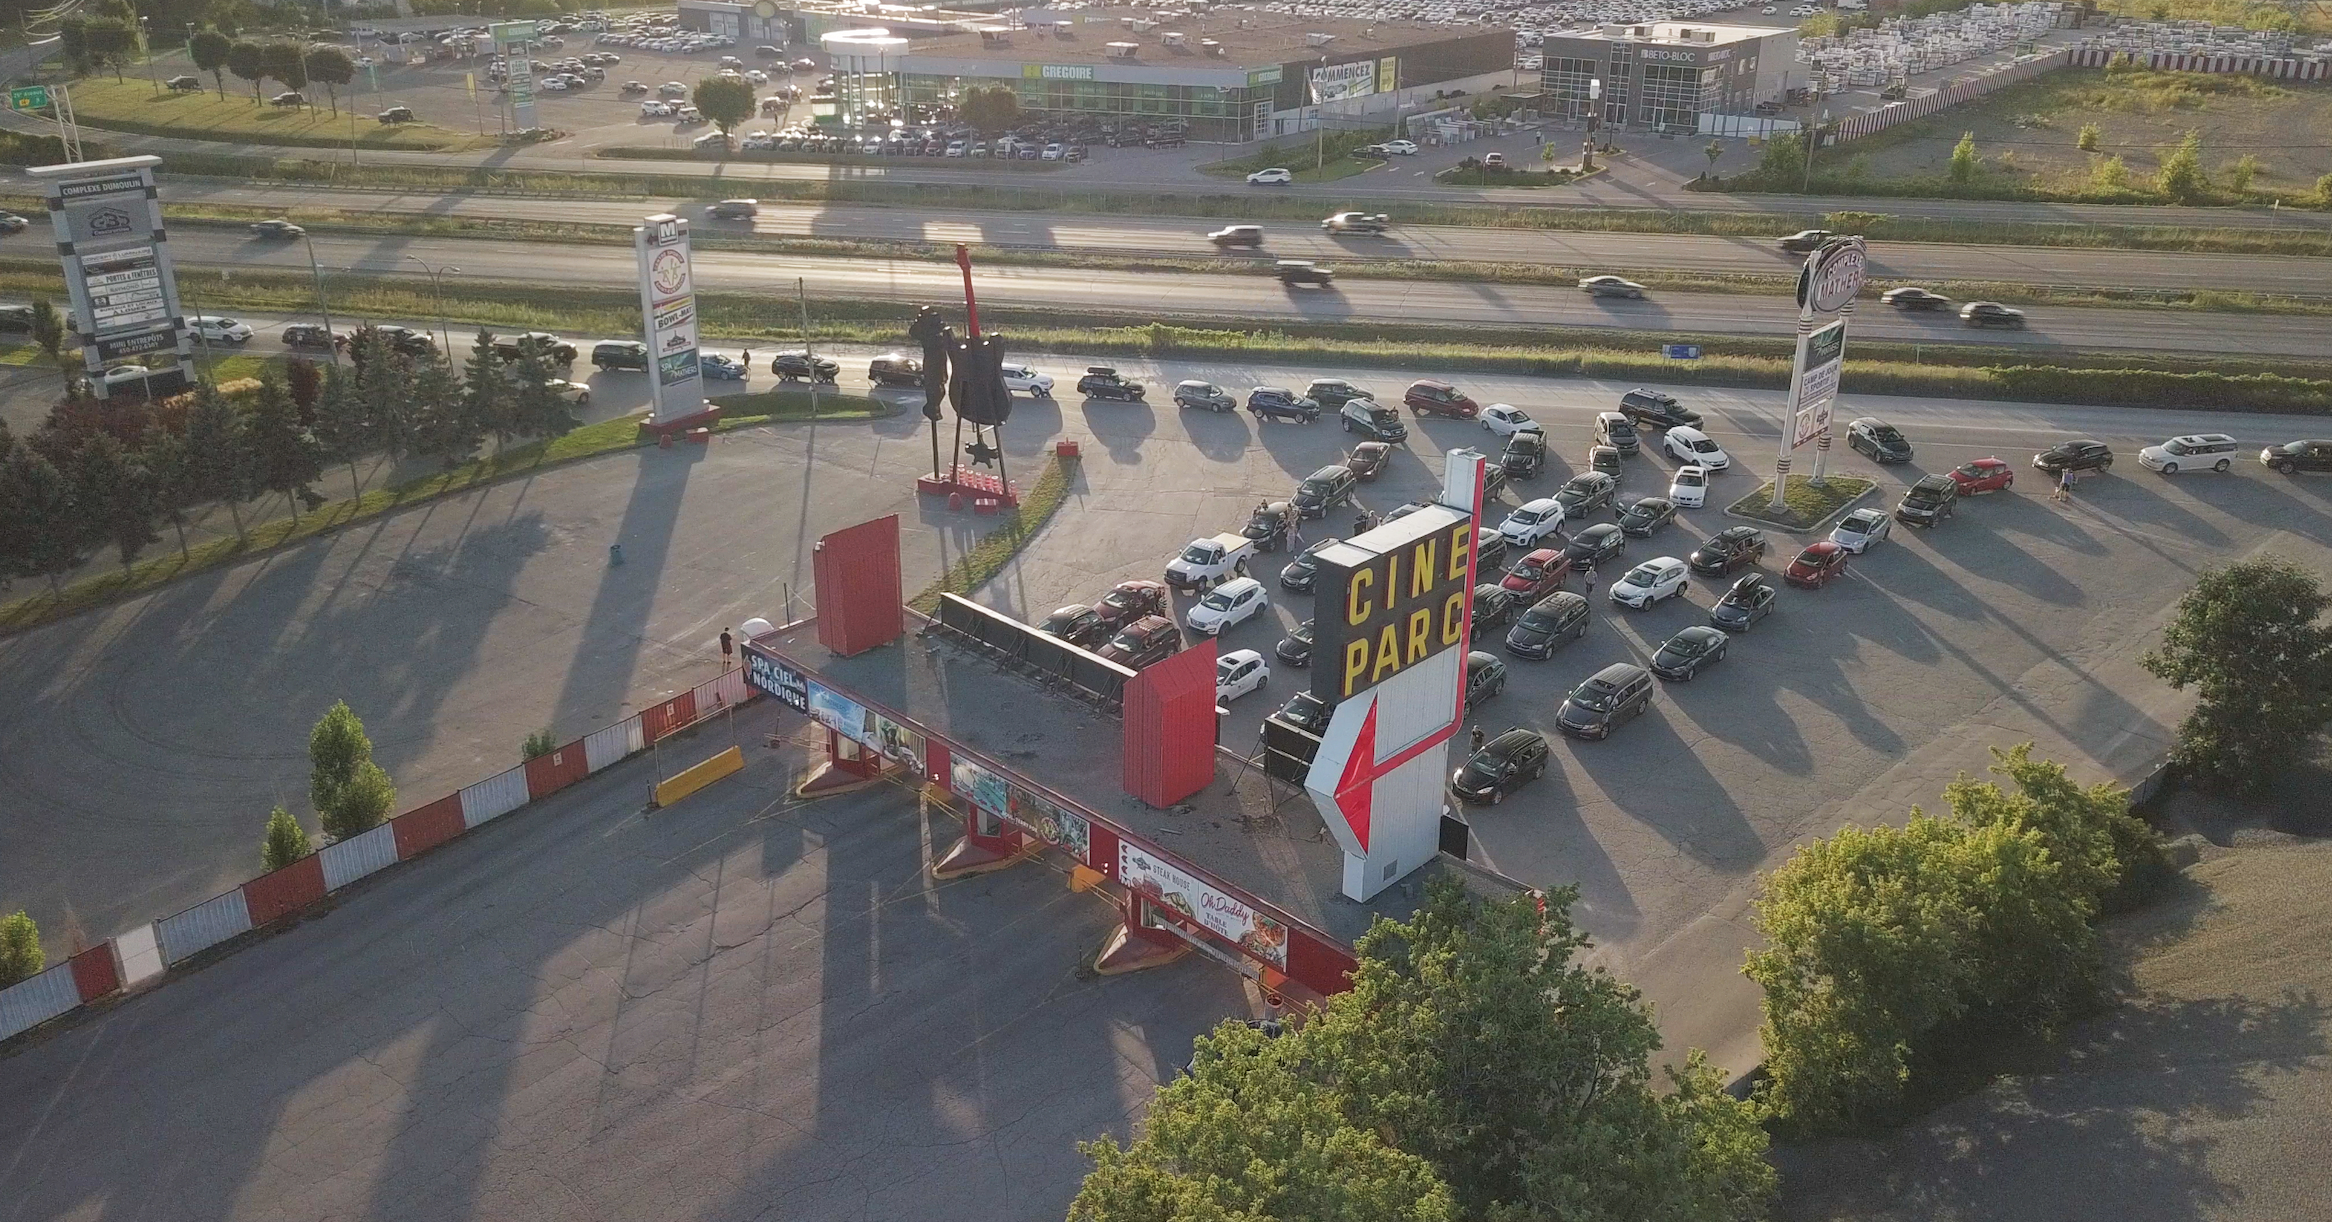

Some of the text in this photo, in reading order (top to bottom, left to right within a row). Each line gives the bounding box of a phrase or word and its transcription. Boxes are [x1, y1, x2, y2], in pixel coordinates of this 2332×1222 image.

[1648, 50, 1696, 62] BETO-BLOC
[1042, 65, 1092, 79] GREGOIRE
[1258, 68, 1281, 82] GREGOIRE
[63, 179, 142, 196] COMPLEXE DUMOULIN
[660, 222, 676, 237] M
[1827, 253, 1864, 279] COMPLEXE
[105, 273, 126, 283] PORTES
[1817, 267, 1866, 301] MATHERS
[1348, 524, 1470, 626] CINE
[1344, 591, 1464, 697] PARC
[751, 655, 771, 675] SPA
[753, 671, 806, 710] NORDIQUE
[1152, 864, 1171, 881] STEAK
[1172, 874, 1191, 892] HOUSE
[1206, 912, 1227, 928] TABLE
[1214, 896, 1249, 927] Daddy
